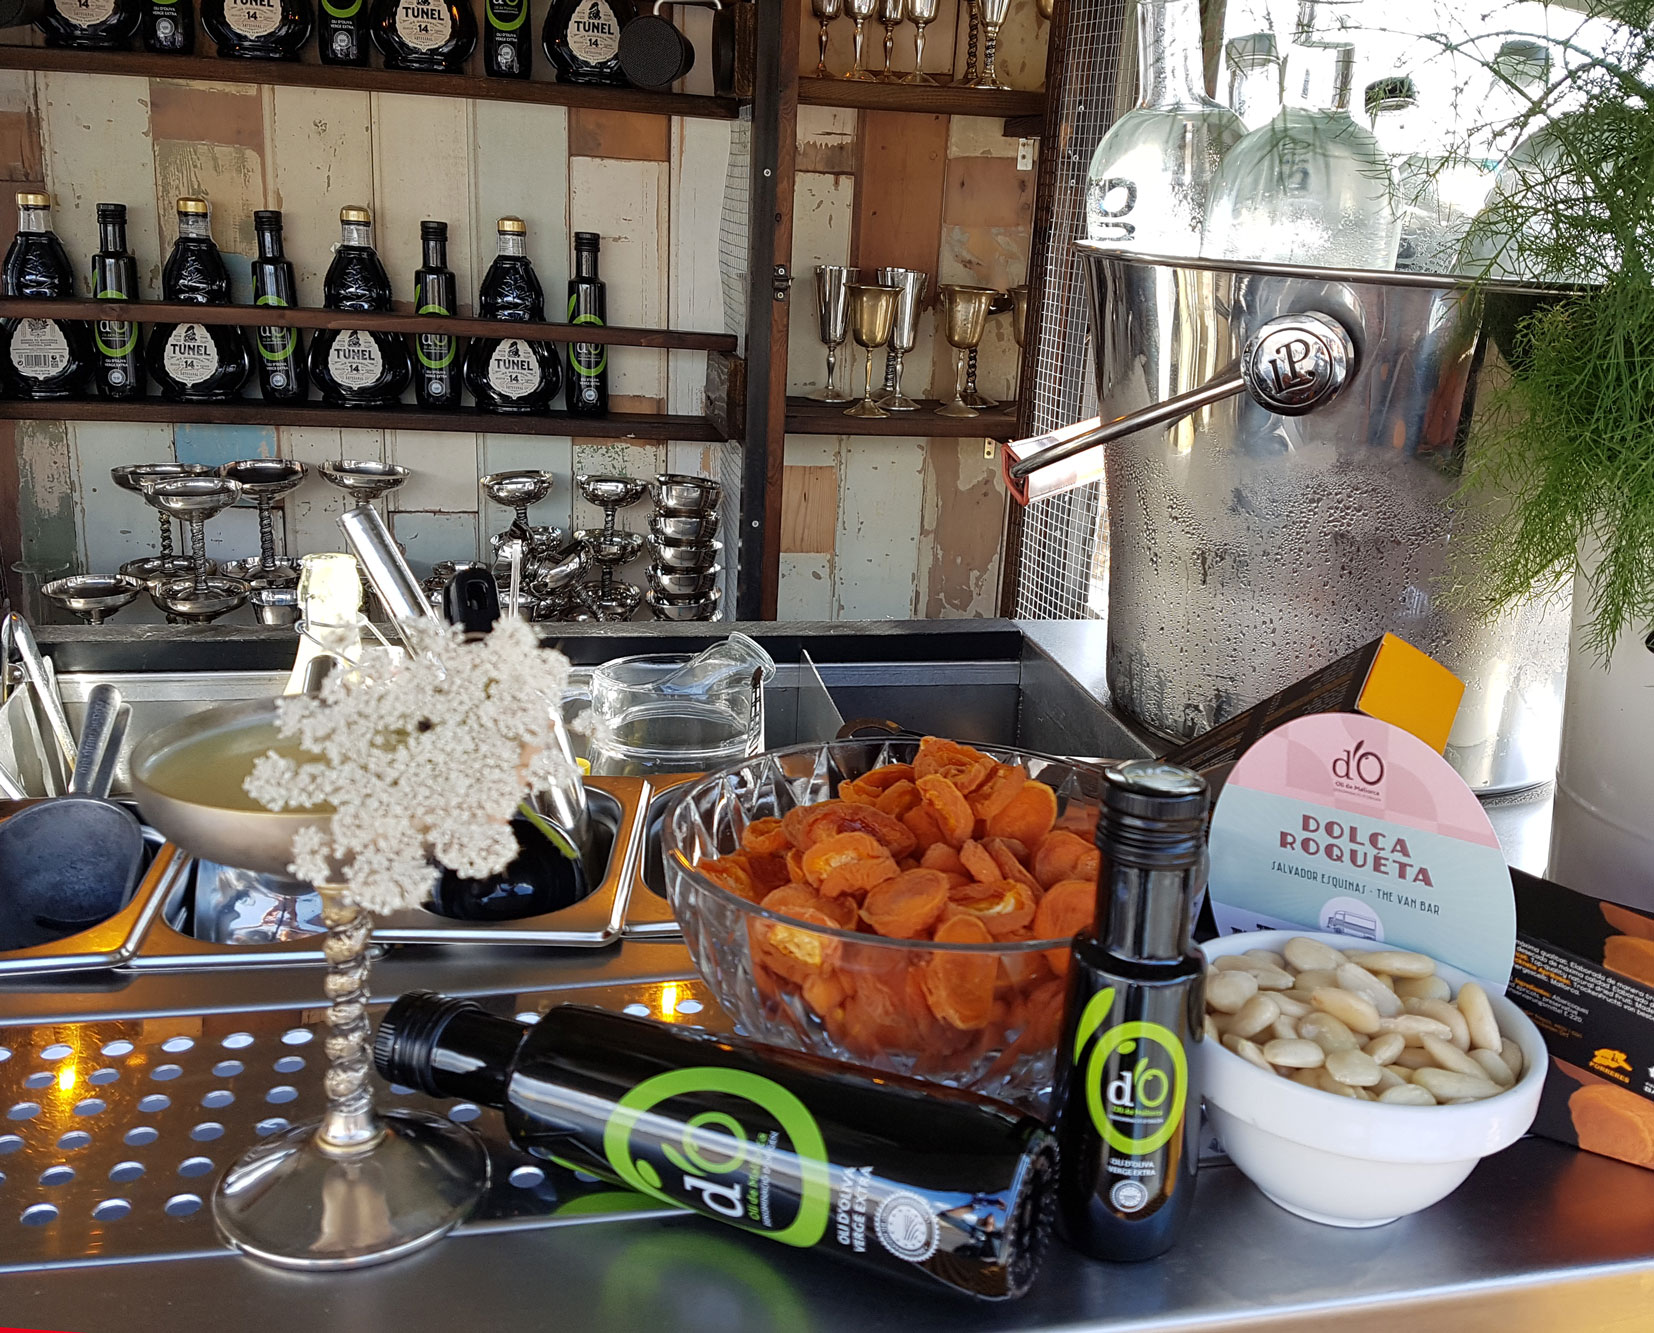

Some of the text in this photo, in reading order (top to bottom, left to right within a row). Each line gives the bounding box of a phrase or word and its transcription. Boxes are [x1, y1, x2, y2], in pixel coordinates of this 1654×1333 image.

[246, 11, 258, 20] 14
[418, 24, 429, 33] 14
[588, 38, 599, 48] 14
[184, 360, 195, 368] 14
[350, 364, 360, 373] 14
[508, 374, 520, 383] 14
[1272, 861, 1318, 882] SALVADOR
[1322, 873, 1367, 895] ESQUINAS
[1377, 888, 1394, 903] THE
[1397, 894, 1417, 909] VAN
[1420, 900, 1440, 916] BAR
[852, 1214, 866, 1253] VERGE
